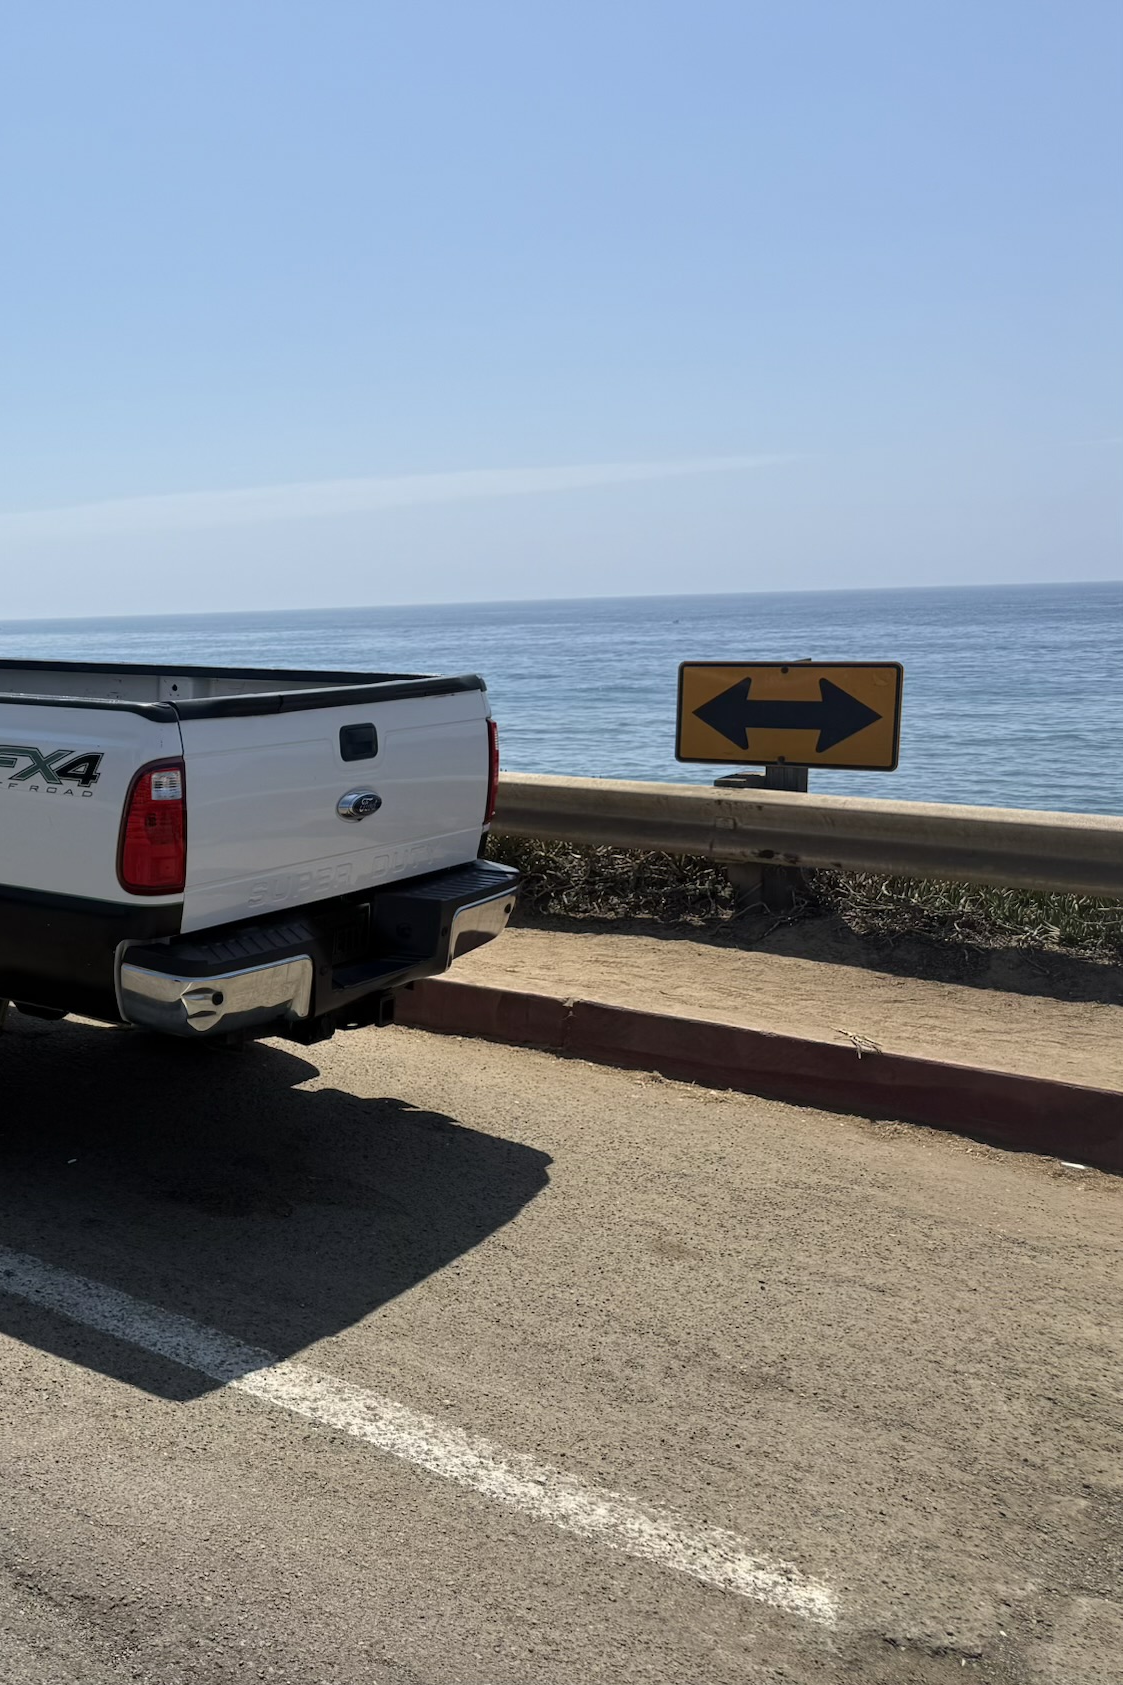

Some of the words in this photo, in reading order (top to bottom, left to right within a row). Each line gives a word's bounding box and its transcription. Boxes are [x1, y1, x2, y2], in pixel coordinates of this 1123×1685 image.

[29, 785, 93, 797] ROAD
[248, 863, 357, 907] SUPER
[370, 842, 440, 878] DUTY
